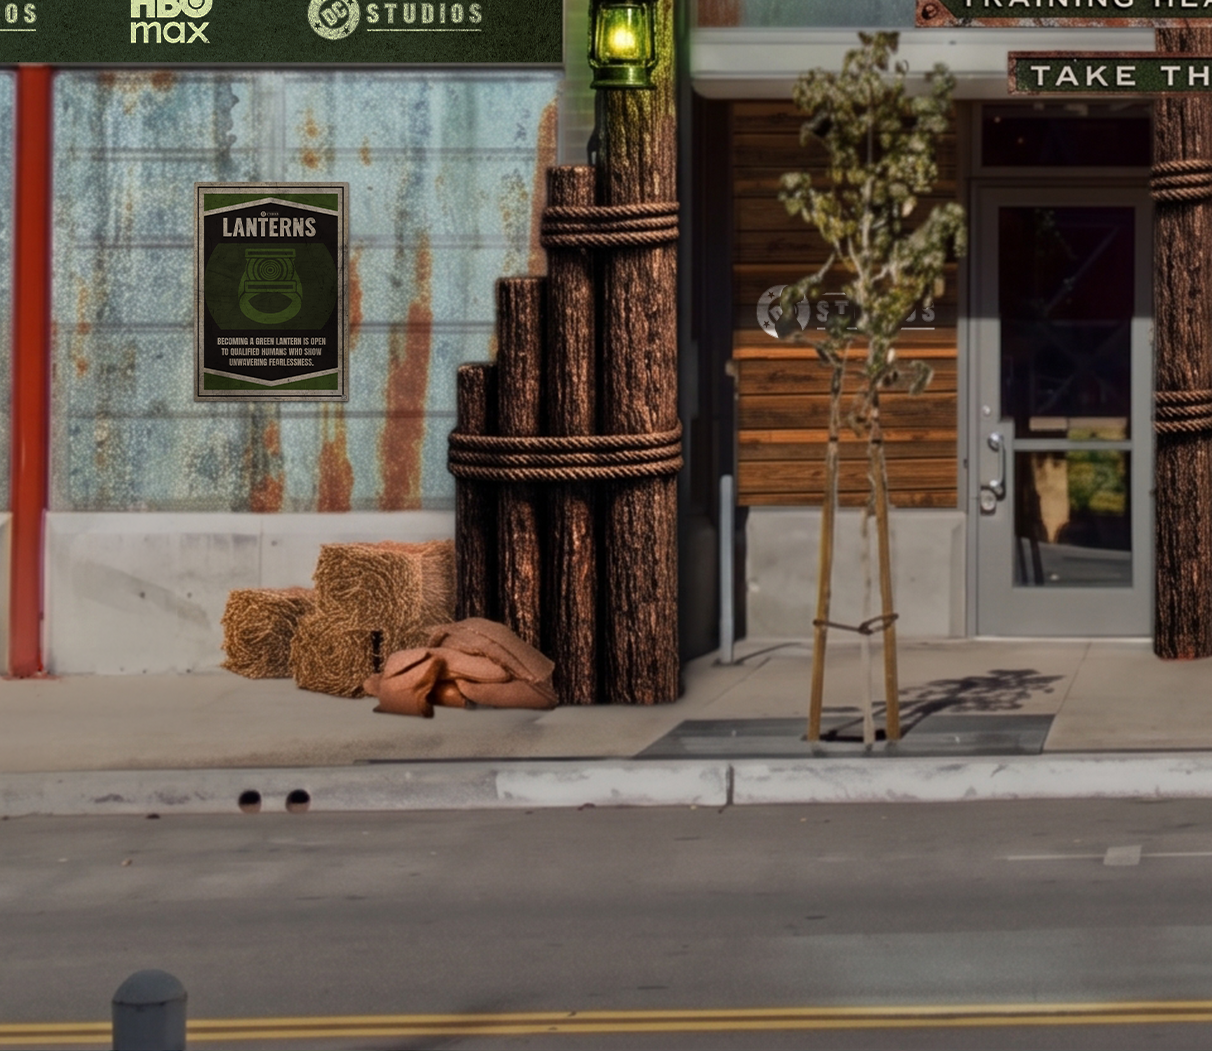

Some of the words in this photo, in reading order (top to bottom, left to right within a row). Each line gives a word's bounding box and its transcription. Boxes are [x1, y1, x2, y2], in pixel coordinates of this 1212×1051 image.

[366, 3, 482, 24] STUDIOS
[130, 21, 211, 44] max
[1030, 64, 1137, 87] TAKE
[222, 217, 317, 238] LANTERNS
[217, 337, 248, 346] BECOMING
[249, 337, 254, 346] A
[255, 337, 275, 346] GREEN
[276, 337, 302, 346] LANTERN
[303, 337, 310, 346] IS
[310, 337, 326, 346] OPEN
[221, 347, 229, 356] TO
[230, 347, 260, 356] QUALIFIED
[261, 347, 287, 356] HUMANS
[288, 347, 303, 356] WHO
[304, 347, 322, 356] SHOW
[229, 358, 267, 367] UNWAVERING
[268, 358, 314, 367] FEARLESSNESS.
